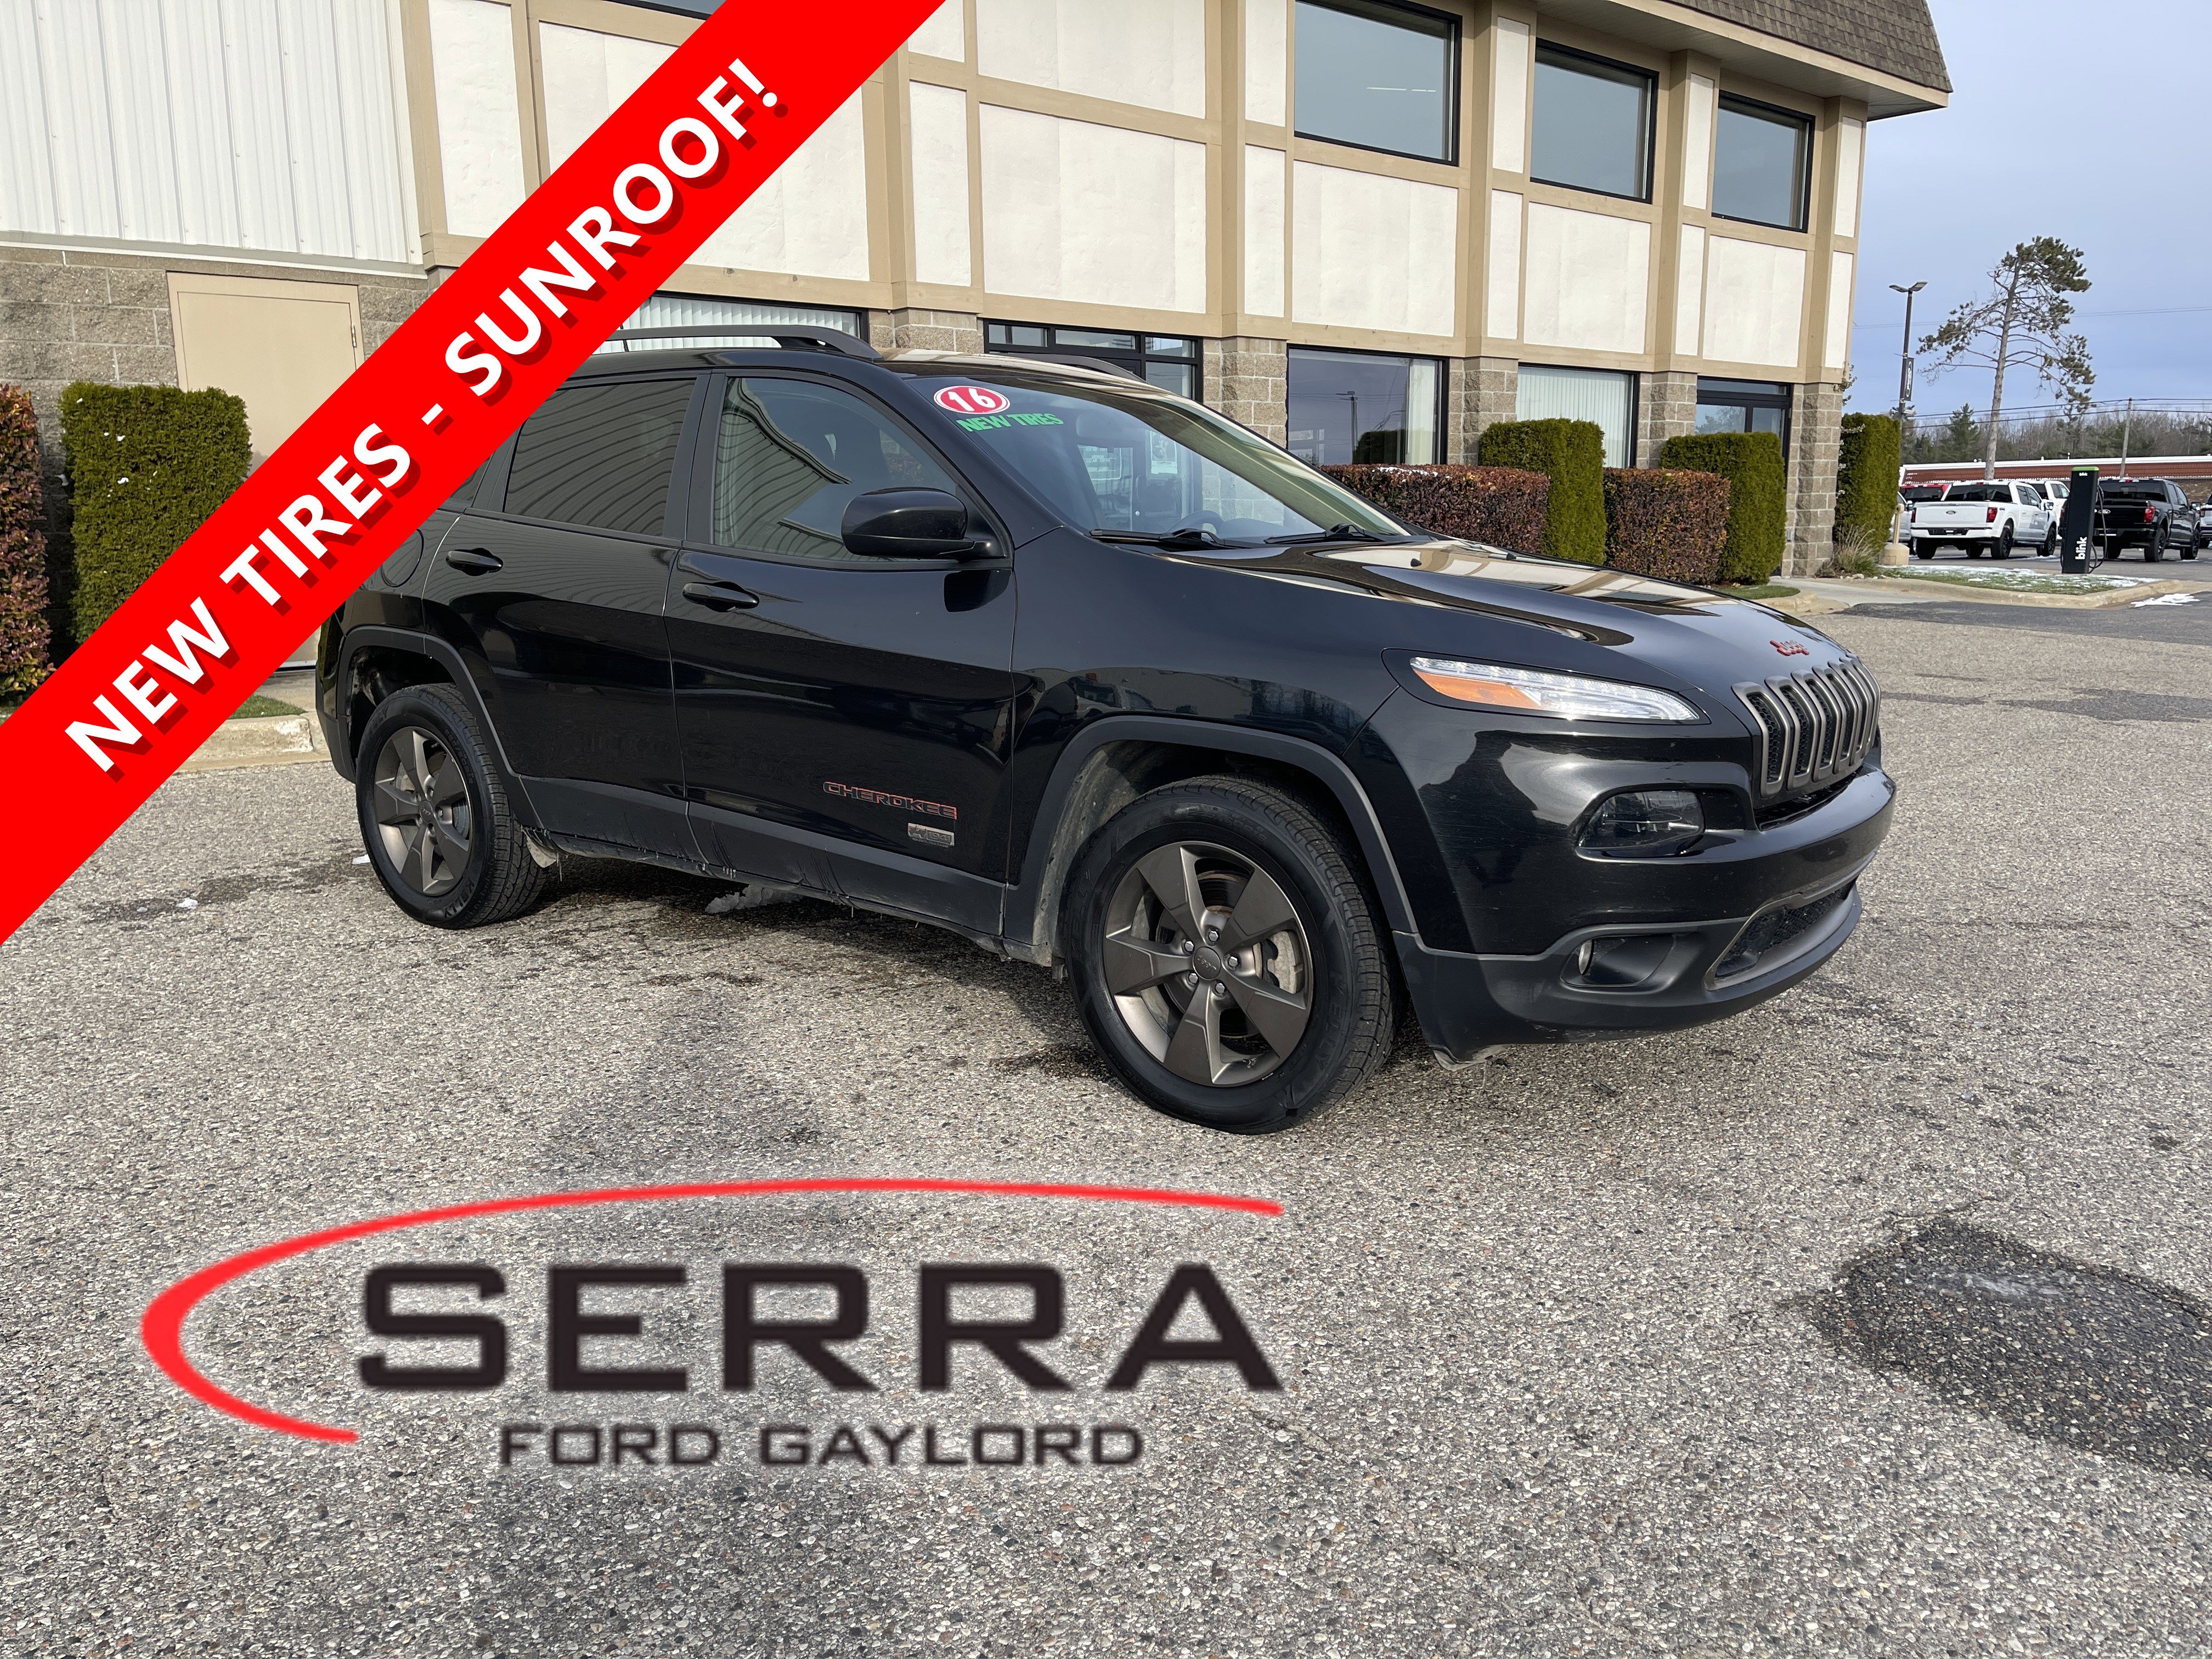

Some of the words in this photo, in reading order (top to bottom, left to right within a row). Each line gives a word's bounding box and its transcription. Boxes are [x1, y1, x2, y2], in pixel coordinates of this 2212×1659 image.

[947, 387, 997, 412] 16
[956, 415, 1012, 432] NEW
[1006, 413, 1064, 427] TIRES
[2075, 536, 2087, 560] blink
[823, 781, 957, 820] CHEROKEE
[444, 877, 476, 918] KELLY
